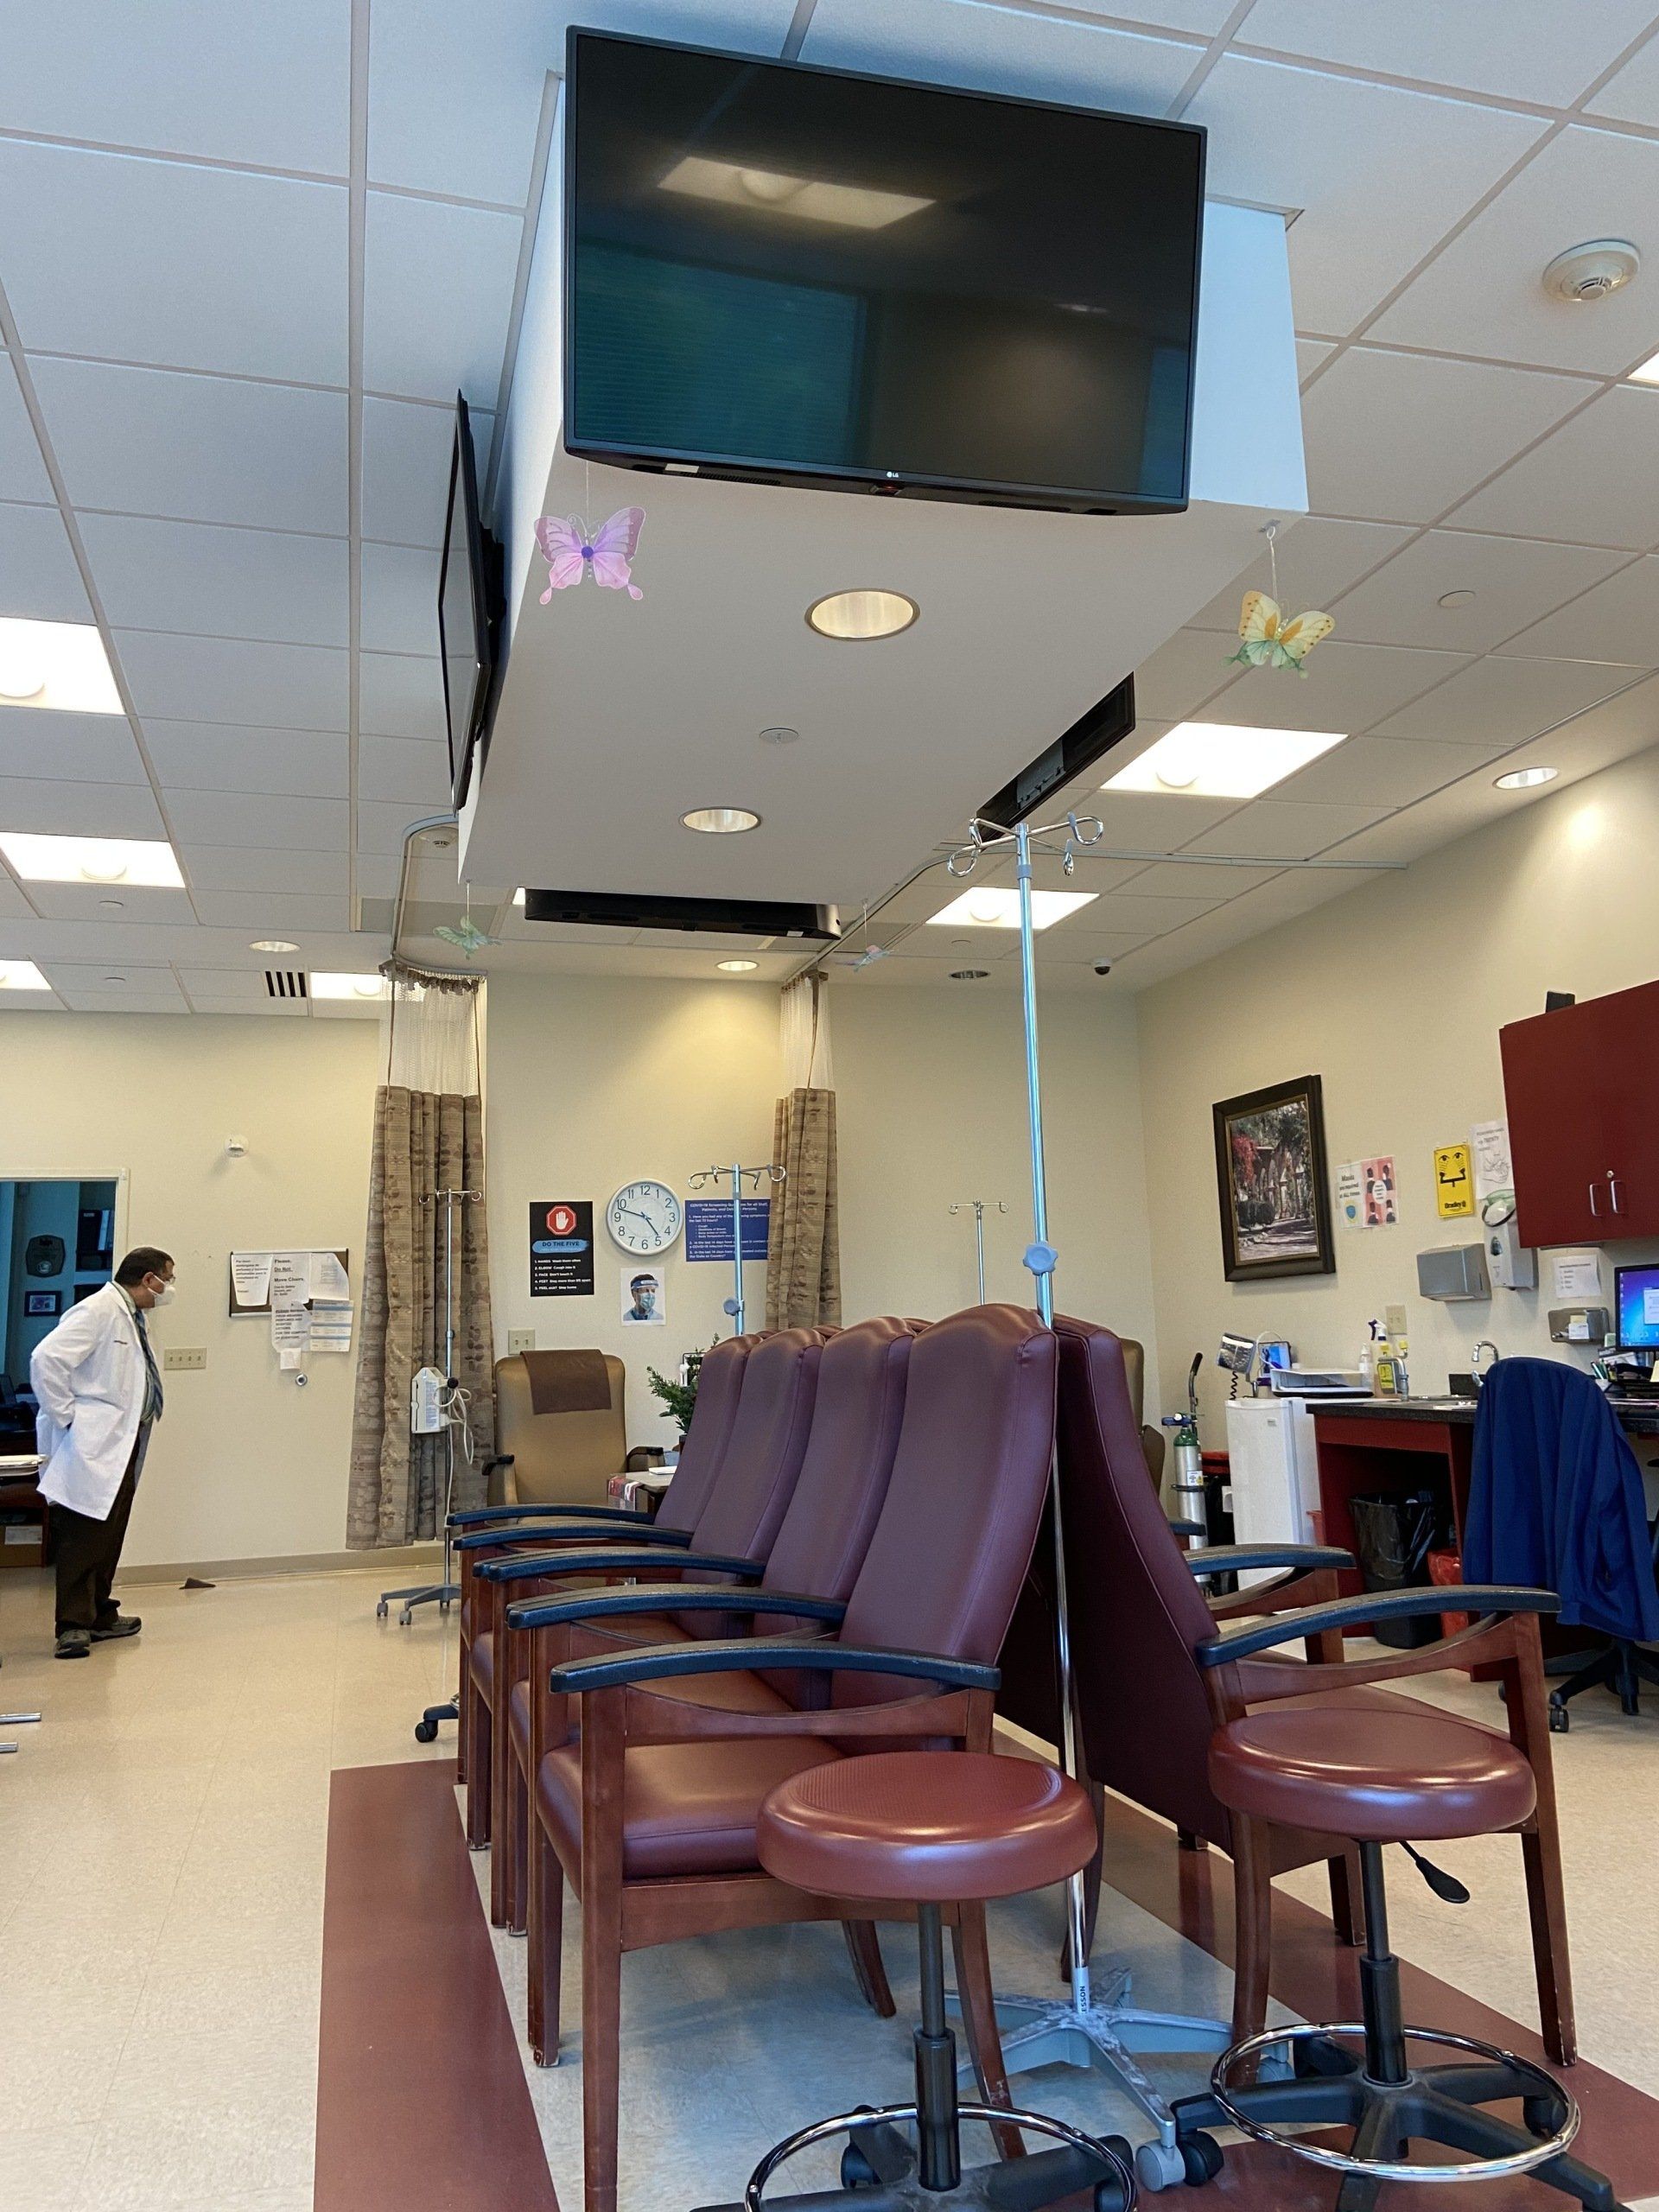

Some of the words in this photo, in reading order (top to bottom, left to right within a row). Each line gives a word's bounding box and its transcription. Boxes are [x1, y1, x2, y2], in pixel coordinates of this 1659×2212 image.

[628, 1188, 634, 1199] 11
[639, 1185, 651, 1195] 12
[656, 1189, 659, 1198] 1
[617, 1198, 626, 1209] 10
[664, 1198, 672, 1208] 2
[613, 1211, 621, 1222] 9
[669, 1212, 676, 1222] 3
[619, 1226, 625, 1236] 8
[664, 1225, 671, 1236] 4
[628, 1236, 635, 1247] 7
[641, 1239, 648, 1249] 6
[655, 1236, 662, 1246] 5
